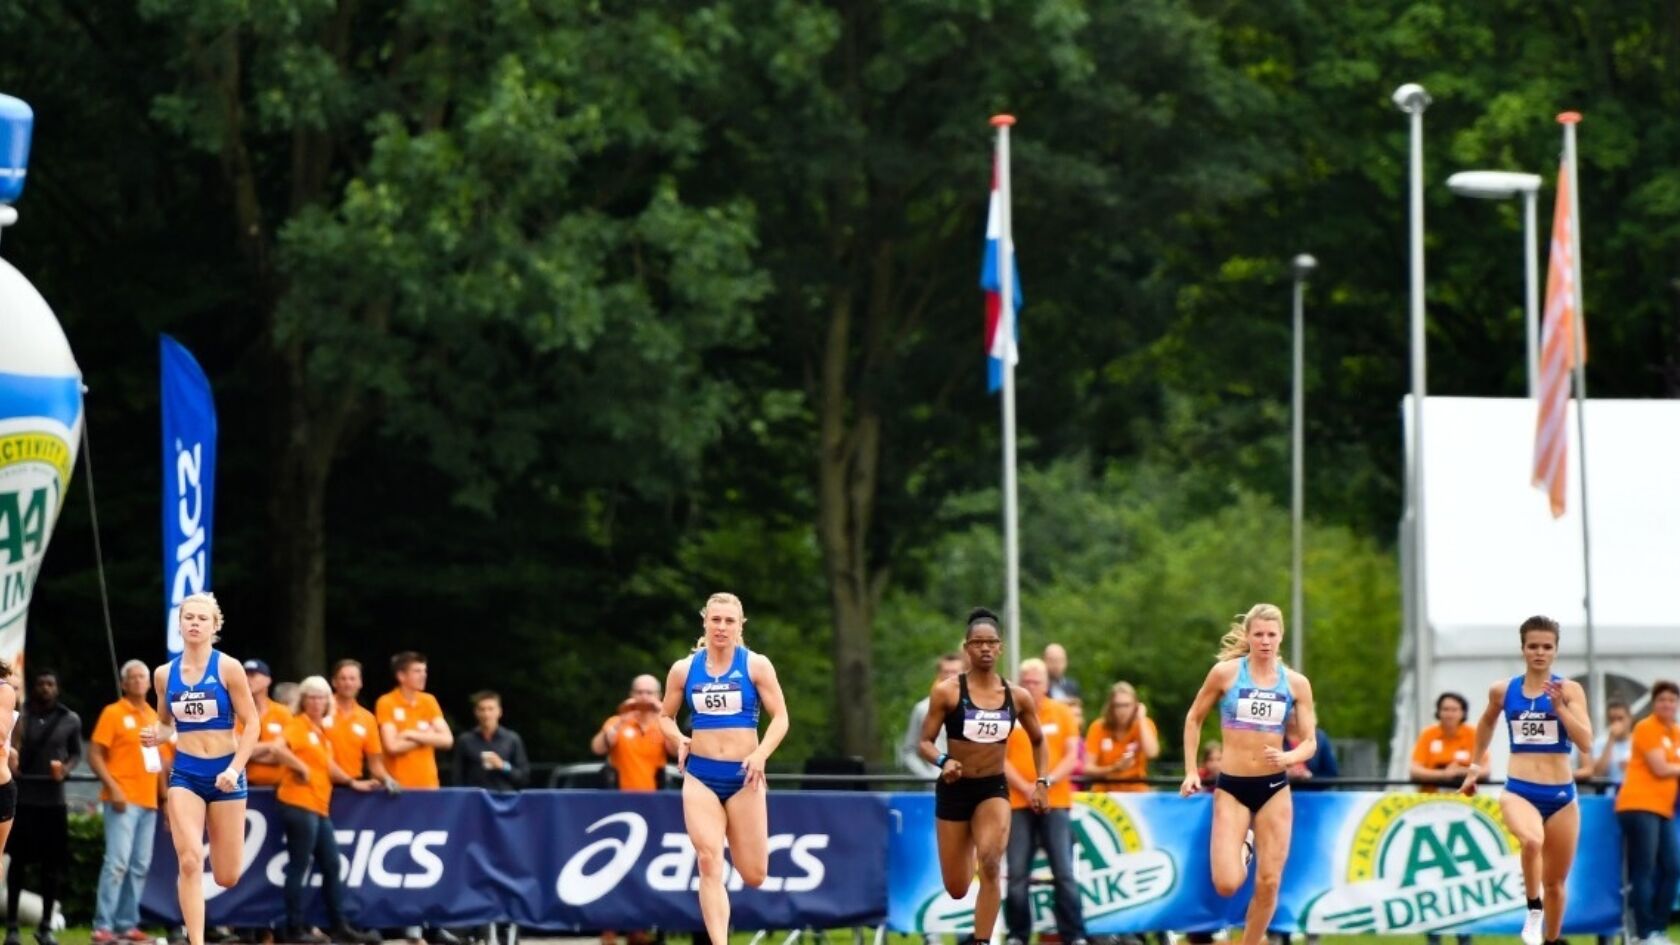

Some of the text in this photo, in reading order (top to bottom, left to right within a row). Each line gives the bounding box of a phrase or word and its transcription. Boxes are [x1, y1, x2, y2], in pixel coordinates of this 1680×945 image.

[184, 702, 204, 715] 478
[705, 694, 727, 709] 651
[1251, 701, 1272, 717] 681
[977, 722, 998, 736] 713
[1521, 722, 1545, 736] 584
[1401, 821, 1493, 888] AA
[1383, 873, 1515, 930] DRINK
